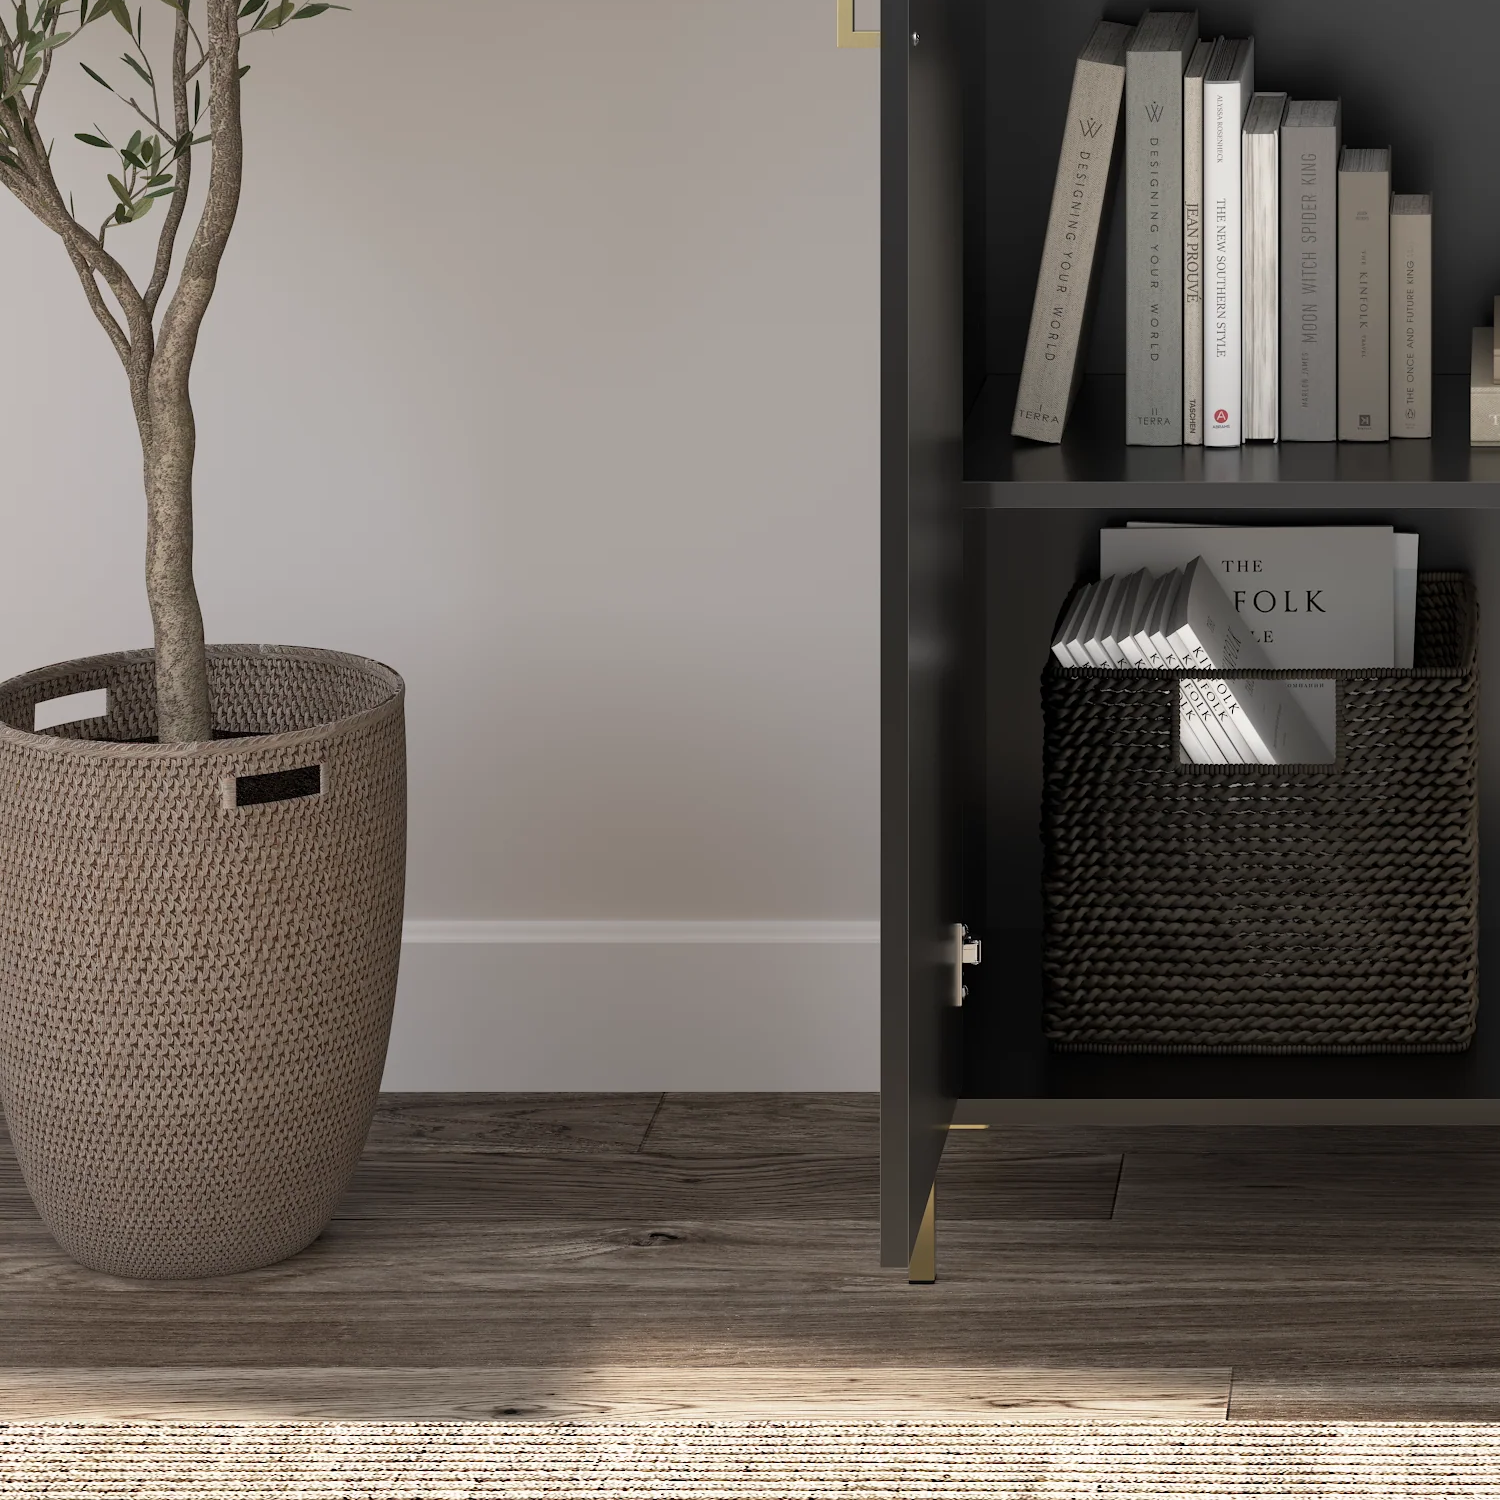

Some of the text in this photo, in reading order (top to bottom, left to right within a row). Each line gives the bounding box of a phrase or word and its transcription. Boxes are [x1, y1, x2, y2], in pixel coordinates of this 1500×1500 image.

[1216, 124, 1224, 163] ROSENHECK
[1301, 153, 1317, 186] KING
[1301, 194, 1317, 243] SPIDER
[1045, 151, 1091, 361] DESIGNING YOUR WORLD
[1150, 137, 1159, 361] DESIGNING YOUR WORLD
[1185, 201, 1202, 303] JEAN PROUVÉ
[1217, 199, 1226, 358] THE NEW SOUTHERN STYLE
[1301, 252, 1317, 294] WITCH
[1406, 261, 1415, 285] KING
[1359, 272, 1368, 329] KINFOLK
[1406, 289, 1414, 323] FUTURE
[1301, 304, 1317, 343] MOON
[1406, 328, 1414, 348] AND
[1406, 354, 1415, 383] ONCE
[1406, 388, 1414, 404] THE
[1019, 410, 1059, 424] TERRA
[1137, 417, 1171, 426] TERRA
[1222, 560, 1263, 573] THE
